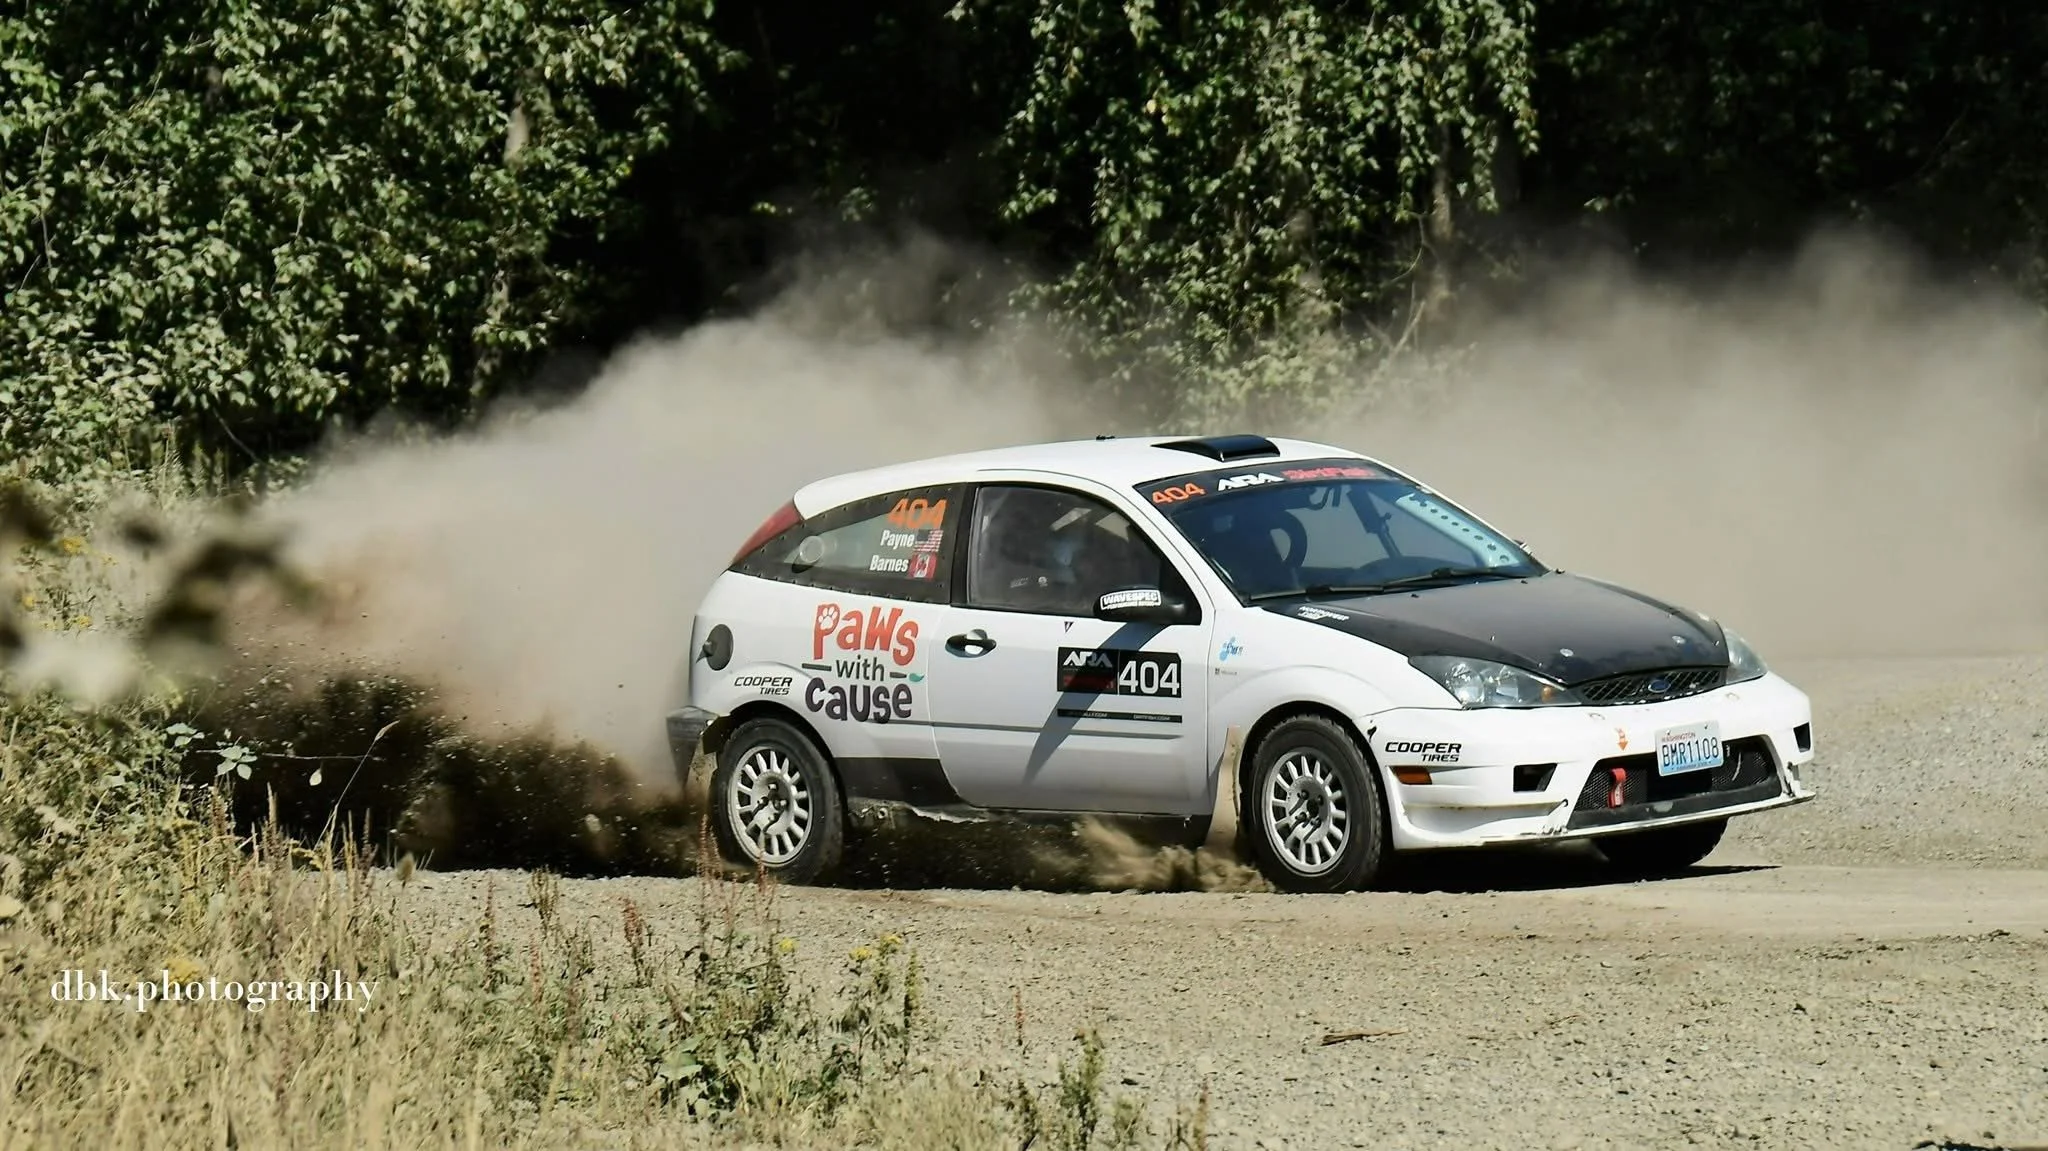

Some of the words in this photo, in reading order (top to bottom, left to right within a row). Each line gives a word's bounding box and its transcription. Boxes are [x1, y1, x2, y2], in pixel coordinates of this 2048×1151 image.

[1152, 482, 1206, 504] 404
[887, 498, 947, 529] 404
[880, 529, 915, 549] Payne
[869, 554, 910, 572] Barnes
[836, 655, 884, 681] with
[1119, 660, 1180, 695] 404
[734, 676, 793, 687] COOPER
[759, 687, 790, 695] TIRES
[1385, 742, 1462, 753] COOPER
[1661, 737, 1719, 767] BMR1108
[1422, 754, 1460, 762] TIRES
